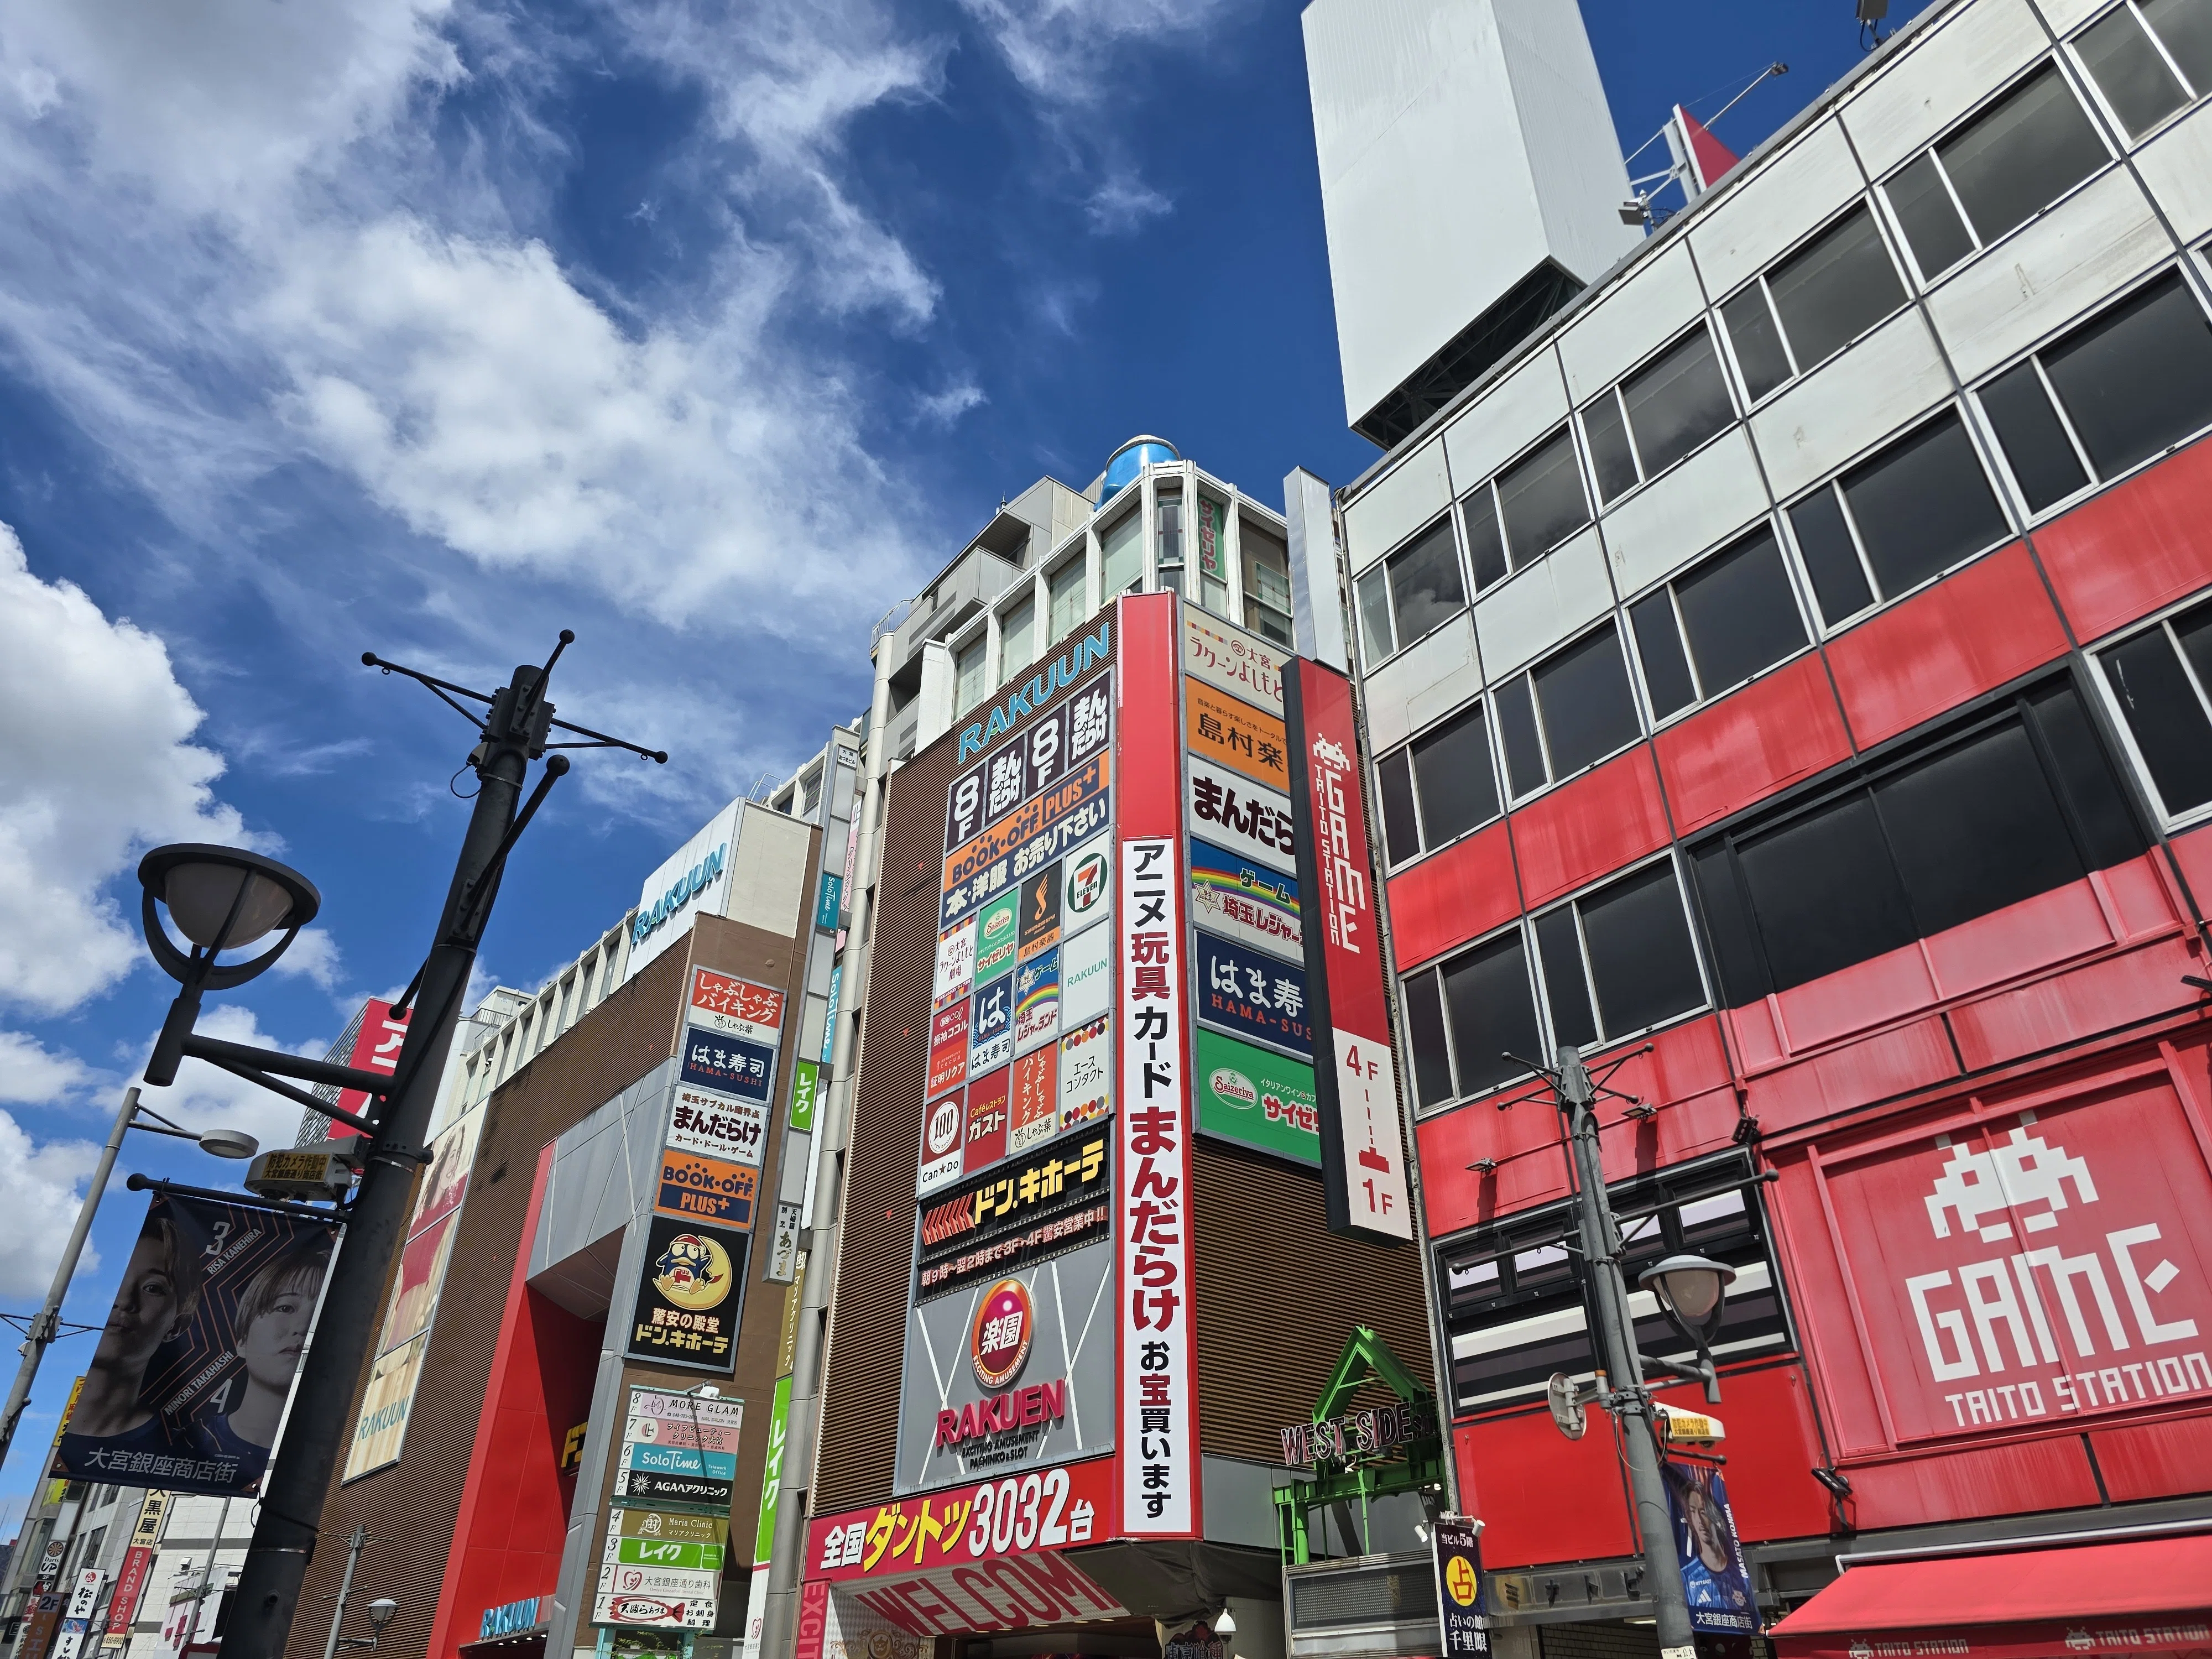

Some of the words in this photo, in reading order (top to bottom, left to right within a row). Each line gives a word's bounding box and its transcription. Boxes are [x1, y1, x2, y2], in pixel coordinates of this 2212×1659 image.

[1199, 499, 1217, 571] サイゼリヤ
[1247, 648, 1271, 670] 大宮
[958, 622, 1109, 763] RAKUUN
[1032, 718, 1061, 787] 8F
[954, 775, 980, 842] 8F
[1193, 776, 1296, 855] まんだら
[1315, 764, 1329, 835] TAITO
[1014, 798, 1105, 877] お売り下さい
[1326, 769, 1365, 953] GAME
[632, 843, 727, 946] RAKUUN
[1240, 868, 1290, 904] ゲーム
[1321, 839, 1339, 946] STATION
[955, 937, 967, 951] 大宮
[977, 941, 1014, 973] サイゼリヤ
[1024, 932, 1055, 957] 島村楽器
[1035, 957, 1058, 980] ゲーム
[1067, 958, 1107, 987] RAKUUN
[700, 973, 779, 1007] しゃぶしゃぶ
[697, 993, 776, 1022] バイキング
[728, 1020, 753, 1034] しゃぶ葉
[933, 1019, 968, 1047] 振袖ココル
[692, 1044, 764, 1077] はま寿司
[971, 1038, 1010, 1071] はま寿司
[1073, 1056, 1095, 1076] エース
[690, 1063, 762, 1087] HAMA-SUSHI
[931, 1061, 965, 1088] 証明リクア
[1067, 1067, 1103, 1094] コンタクト
[1214, 1076, 1254, 1100] Saizeriya
[795, 1072, 812, 1113] レイク
[674, 1106, 761, 1146] まんだらけ
[933, 1109, 953, 1141] 100
[968, 1110, 1005, 1144] ガスト
[1027, 1118, 1051, 1140] しゃぶ葉
[267, 1154, 327, 1168] 防犯カメラ作動中
[1362, 1178, 1392, 1214] 1F
[1129, 1107, 1180, 1332] まんだらけ
[206, 1222, 230, 1255] 3
[207, 1259, 226, 1275] RISA
[223, 1228, 262, 1260] KANEHIRA
[776, 1231, 792, 1277] あづま
[1906, 1223, 2198, 1383] GAME
[651, 1307, 719, 1333] 驚安の殿堂
[785, 1275, 801, 1366] マリアクリニック
[980, 1311, 1023, 1355] 楽園
[973, 1354, 994, 1384] EXCITING
[995, 1340, 1029, 1384] AMUSEMENT
[164, 1388, 194, 1416] MINORI
[191, 1351, 234, 1389] TAKAHASHI
[210, 1378, 232, 1413] 4
[1944, 1381, 2046, 1428] TAITO
[2052, 1352, 2212, 1411] STATION
[357, 1395, 409, 1442] RAKUUN
[669, 1399, 702, 1411] MORE
[707, 1404, 739, 1416] GLAM
[936, 1379, 1066, 1447] RAKUEN
[1139, 1340, 1171, 1518] お宝買います
[1281, 1417, 1346, 1465] WEST
[1356, 1401, 1413, 1452] SIDE
[85, 1447, 238, 1483] 大宮銀座商店街
[765, 1419, 786, 1511] レイク
[668, 1530, 711, 1538] マリアクリニック
[669, 1517, 688, 1526] Maria
[691, 1520, 713, 1529] Clinic
[132, 1537, 153, 1546] 大宮店
[639, 1542, 682, 1561] レイク
[1441, 1532, 1473, 1548] 当ビル5階
[124, 1551, 143, 1592] BRAND
[645, 1576, 711, 1590] 大宮銀座通り歯科
[1453, 1558, 1472, 1601] 占
[38, 1597, 59, 1610] 2F
[75, 1587, 93, 1615] 松のや
[112, 1597, 128, 1630] SHOP
[686, 1609, 714, 1618] お刺身
[480, 1597, 540, 1639] RAKUUN
[1450, 1613, 1484, 1630] 占いの館
[1696, 1611, 1753, 1629] 大宮銀座商店街
[1449, 1630, 1488, 1652] 千里眼
[1875, 1641, 1911, 1657] TAITO
[1914, 1639, 1969, 1656] STATION
[2095, 1629, 2142, 1647] TAITO
[2143, 1624, 2211, 1645] STATION
